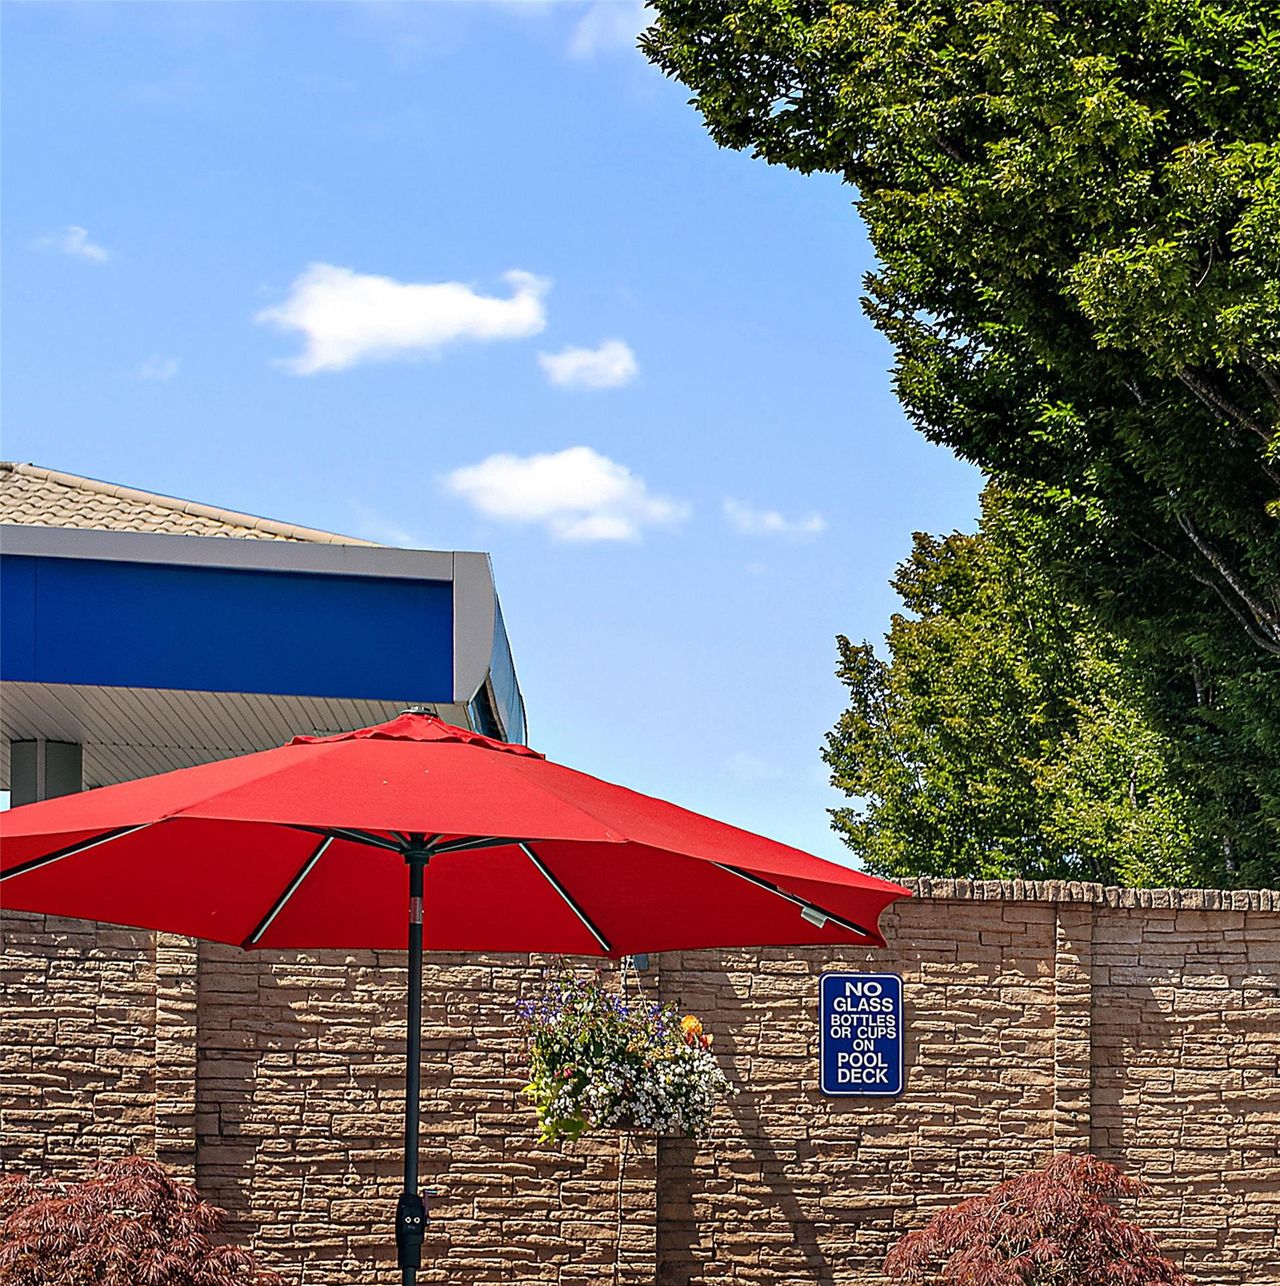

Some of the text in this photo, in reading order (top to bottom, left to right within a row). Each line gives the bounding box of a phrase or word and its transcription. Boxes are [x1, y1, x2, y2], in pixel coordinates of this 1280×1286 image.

[845, 981, 882, 997] NO
[833, 997, 894, 1012] GLASS
[830, 1014, 896, 1027] BOTTLES
[830, 1026, 897, 1039] OR CUPS
[852, 1039, 874, 1051] ON
[837, 1052, 888, 1068] POOL
[837, 1068, 889, 1083] DECK
